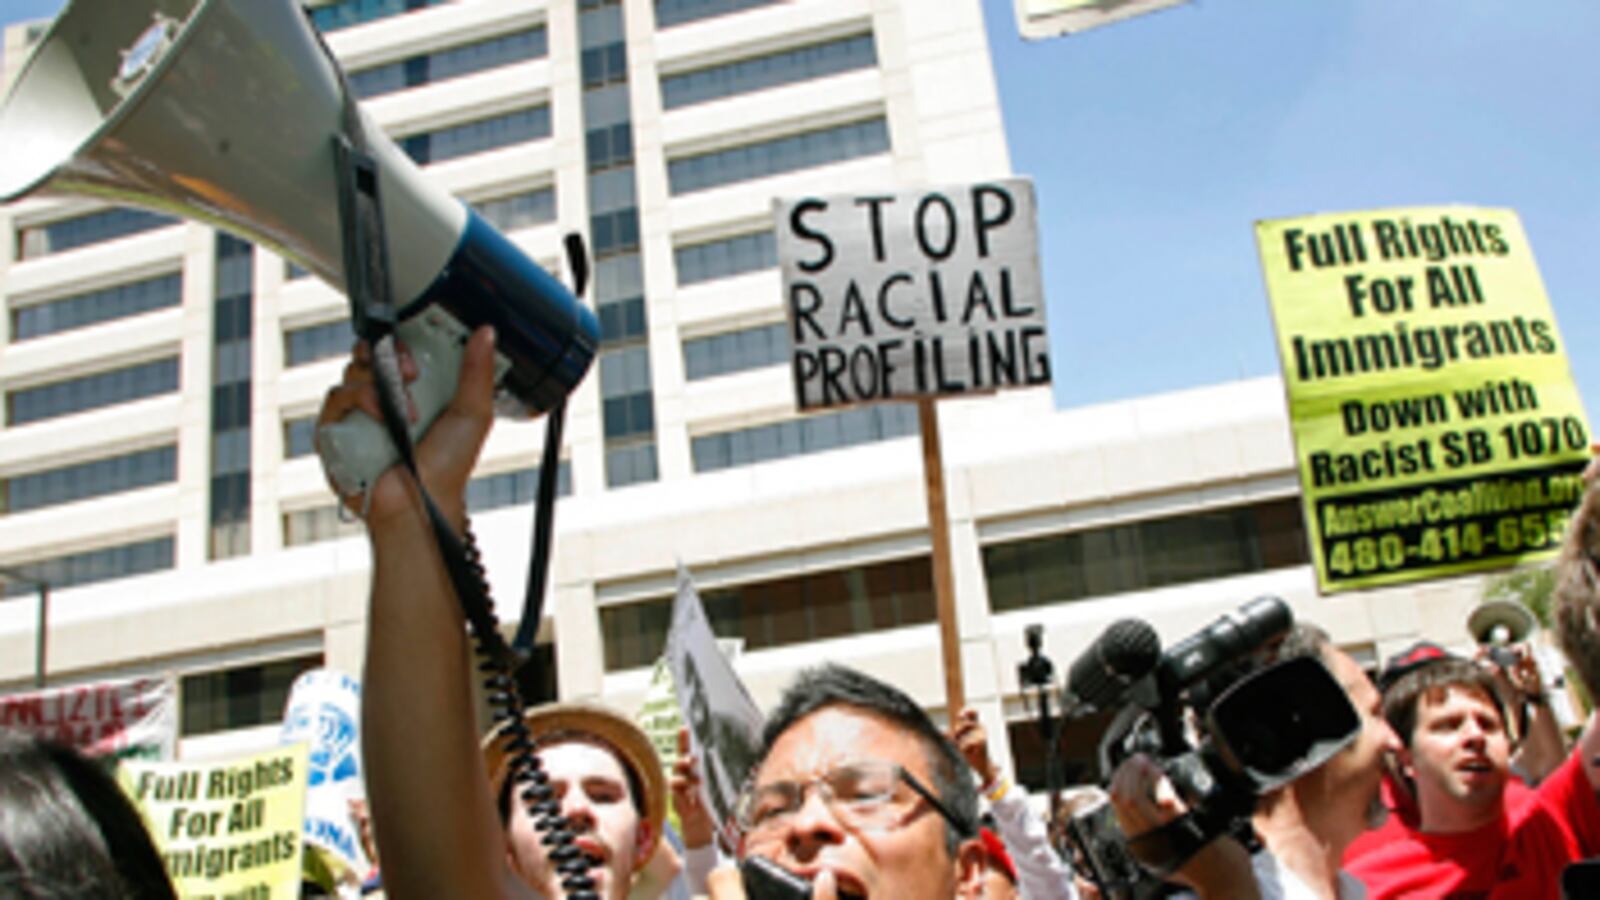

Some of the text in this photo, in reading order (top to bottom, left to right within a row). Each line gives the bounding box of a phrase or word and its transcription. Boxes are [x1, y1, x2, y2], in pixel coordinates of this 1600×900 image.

[789, 184, 1015, 273] STOP
[1283, 216, 1510, 271] Full Rights
[790, 266, 1035, 344] RACIAL
[1344, 264, 1485, 318] For All
[794, 326, 1052, 411] PROFILING
[1292, 316, 1556, 381] Immigrants
[1340, 378, 1539, 437] Down with
[1309, 415, 1587, 488] Racist SB 1070
[1324, 473, 1584, 538] AnswerCoalition.or
[137, 756, 294, 801] Full Rights
[169, 798, 266, 840] For All
[163, 830, 298, 881] migrants
